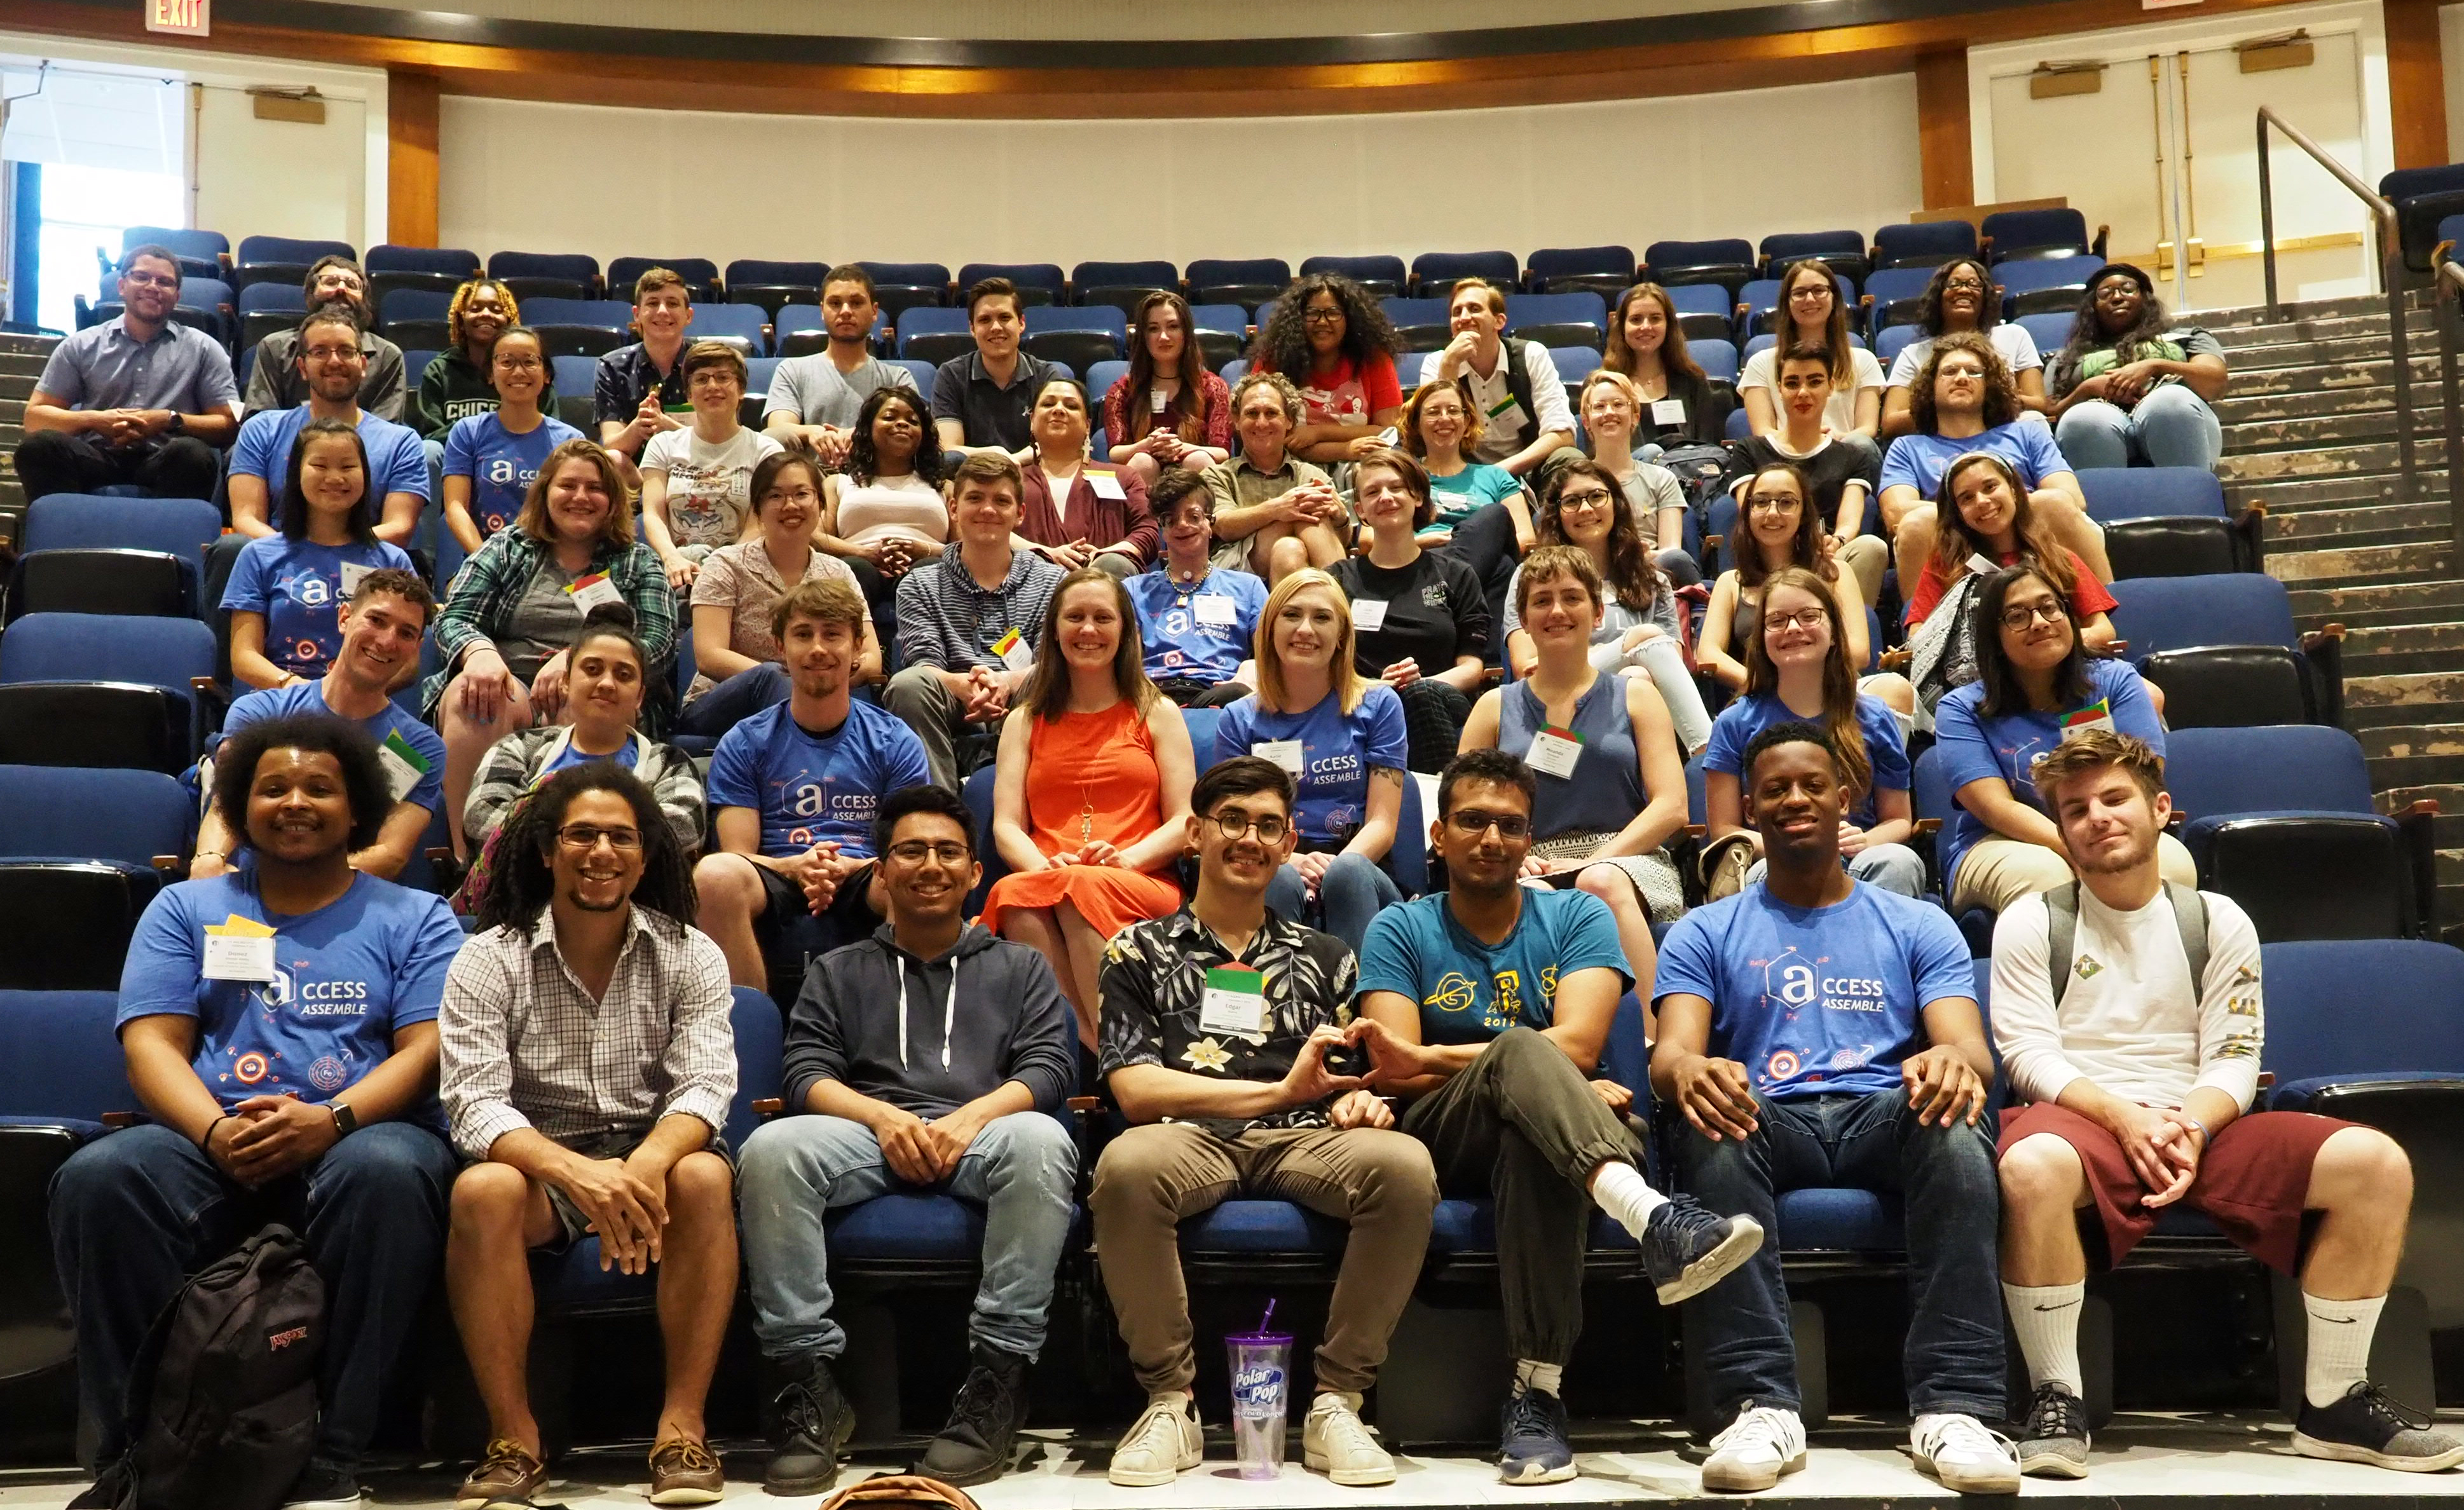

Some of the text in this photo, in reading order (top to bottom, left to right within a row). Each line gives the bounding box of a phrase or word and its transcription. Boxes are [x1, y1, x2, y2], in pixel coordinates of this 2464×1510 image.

[155, 0, 202, 27] EXIT
[1194, 629, 1231, 642] ASSEMBLE
[1311, 754, 1359, 774] CCESS
[1313, 770, 1362, 786] ASSEMBLE
[832, 795, 877, 809] CCESS
[301, 981, 367, 1000] CCESS
[1821, 977, 1884, 997] CCESS
[300, 1003, 368, 1016] ASSEMBLE
[1821, 998, 1886, 1012] ASSEMBLE
[1483, 1017, 1516, 1028] 2018
[1235, 1368, 1271, 1388] Polar
[1251, 1384, 1278, 1403] Pop
